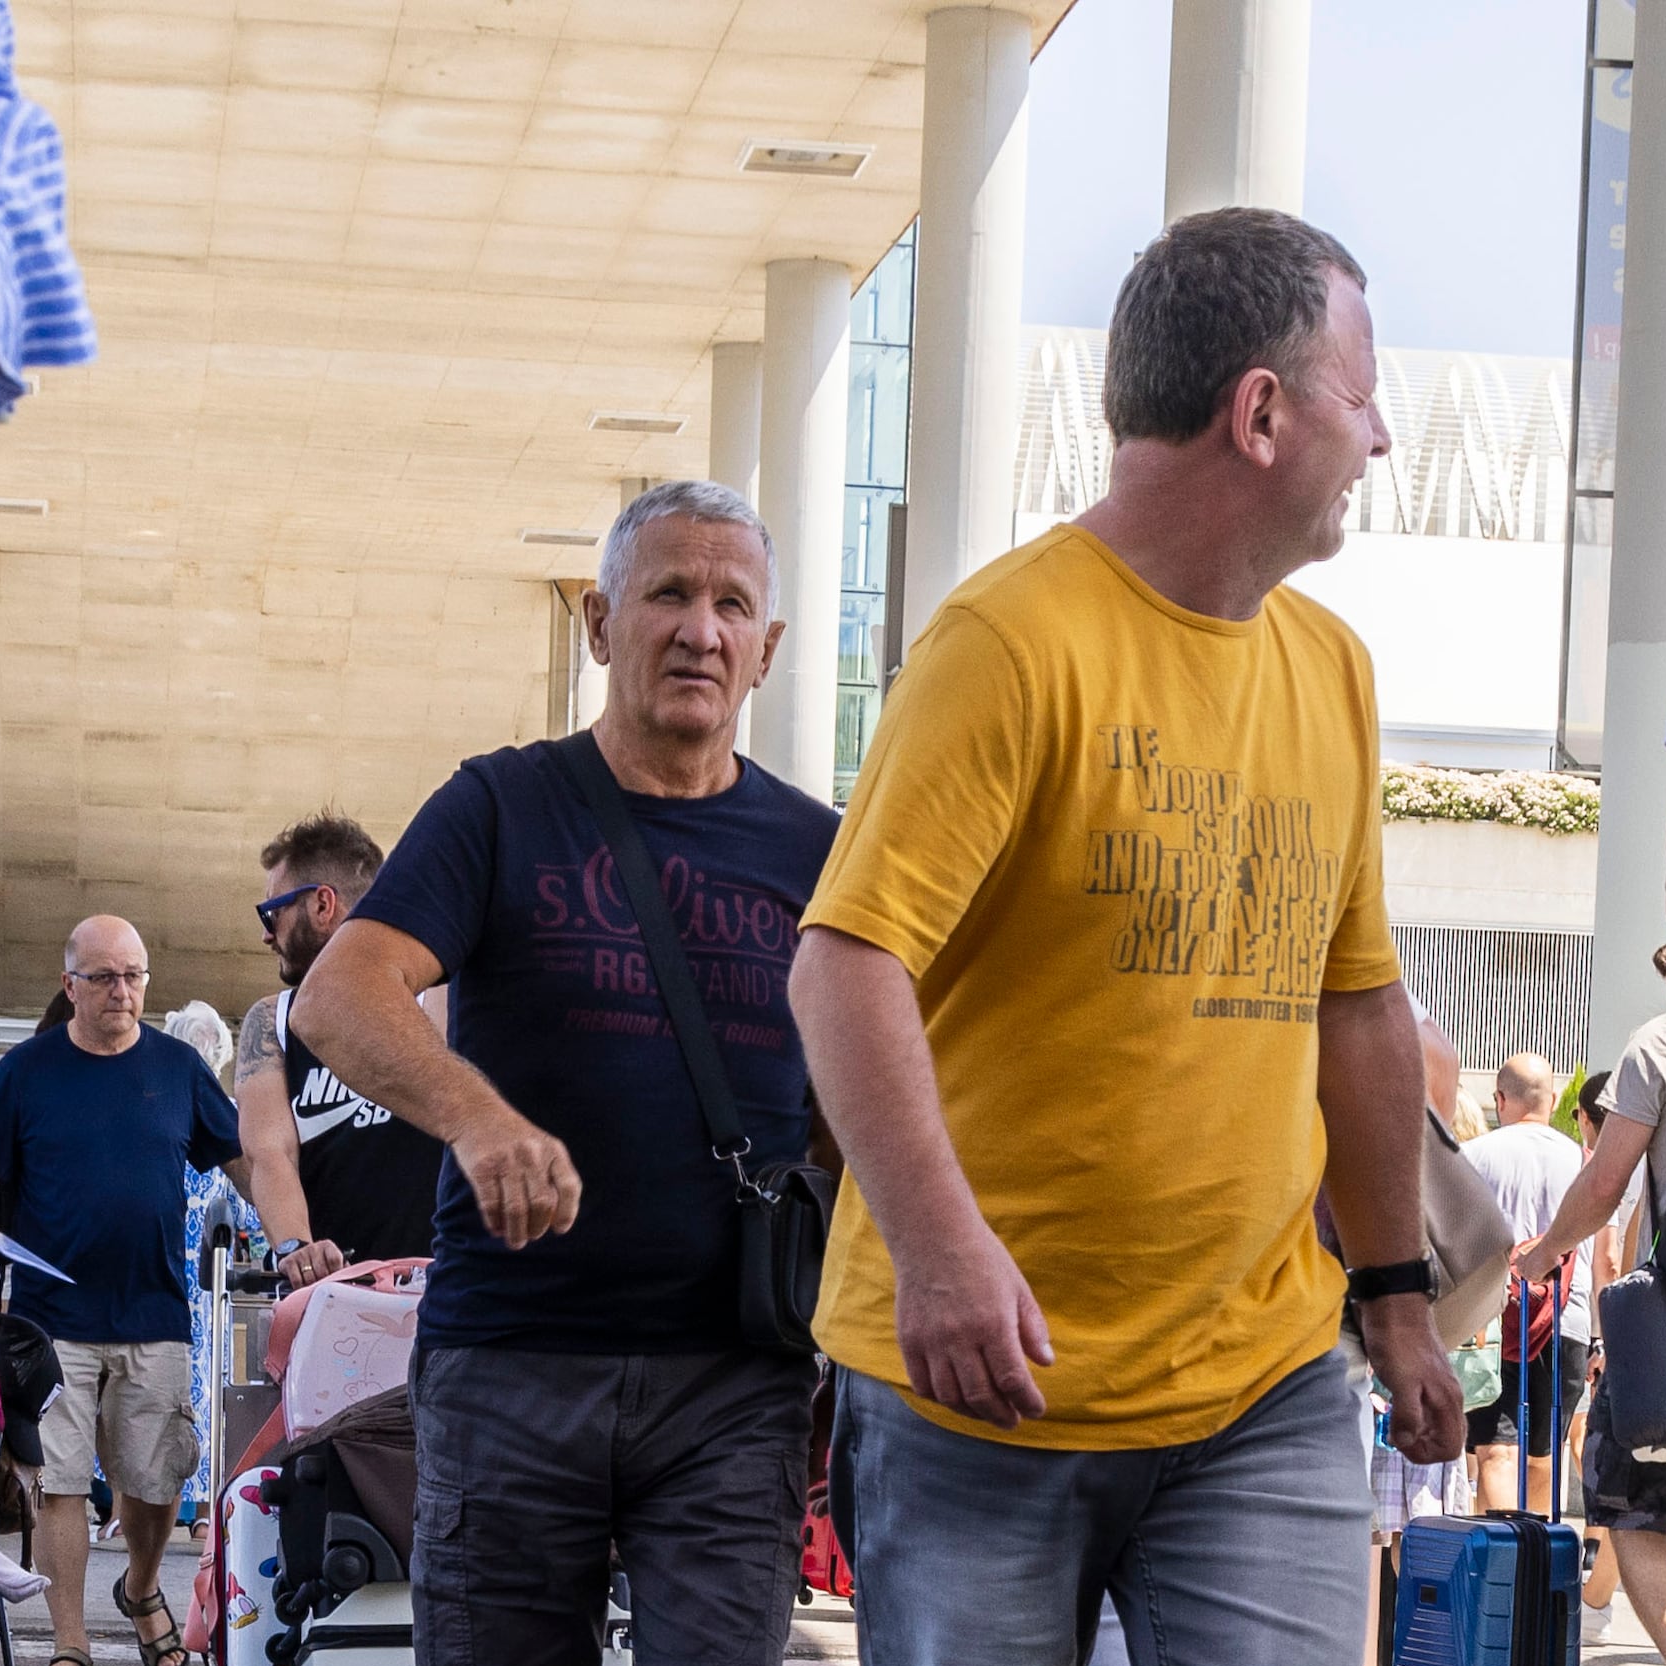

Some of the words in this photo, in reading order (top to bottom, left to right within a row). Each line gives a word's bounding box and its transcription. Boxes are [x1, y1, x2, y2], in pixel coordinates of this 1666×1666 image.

[1097, 724, 1158, 770] THE
[1134, 762, 1244, 818] WORLD
[1186, 810, 1217, 854] IS
[1236, 793, 1313, 861] BOOK
[1084, 829, 1162, 895] AND
[1159, 848, 1248, 896] THOSE
[1125, 887, 1197, 937] NOT
[1110, 929, 1200, 976] ONLY
[1199, 930, 1256, 977] ONE
[1192, 997, 1292, 1023] GLOBETROTTER
